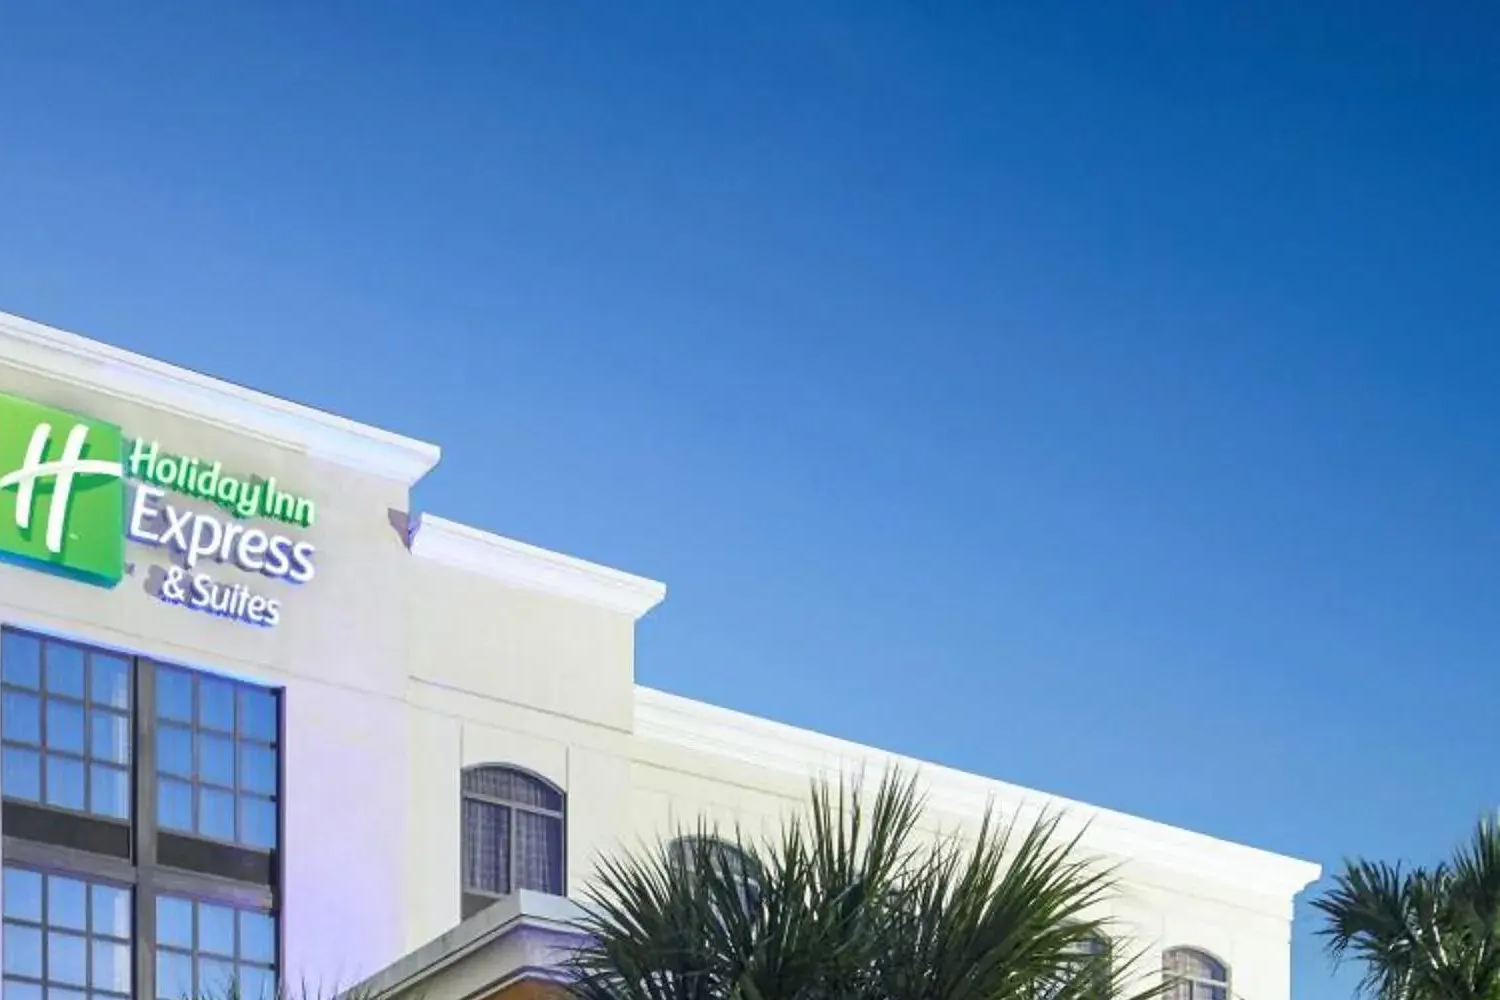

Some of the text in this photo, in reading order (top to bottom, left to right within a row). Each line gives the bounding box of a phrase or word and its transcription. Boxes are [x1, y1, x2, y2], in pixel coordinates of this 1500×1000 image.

[130, 437, 314, 525] Holiday Inn
[130, 485, 315, 582] Express
[162, 566, 281, 626] & Suites
